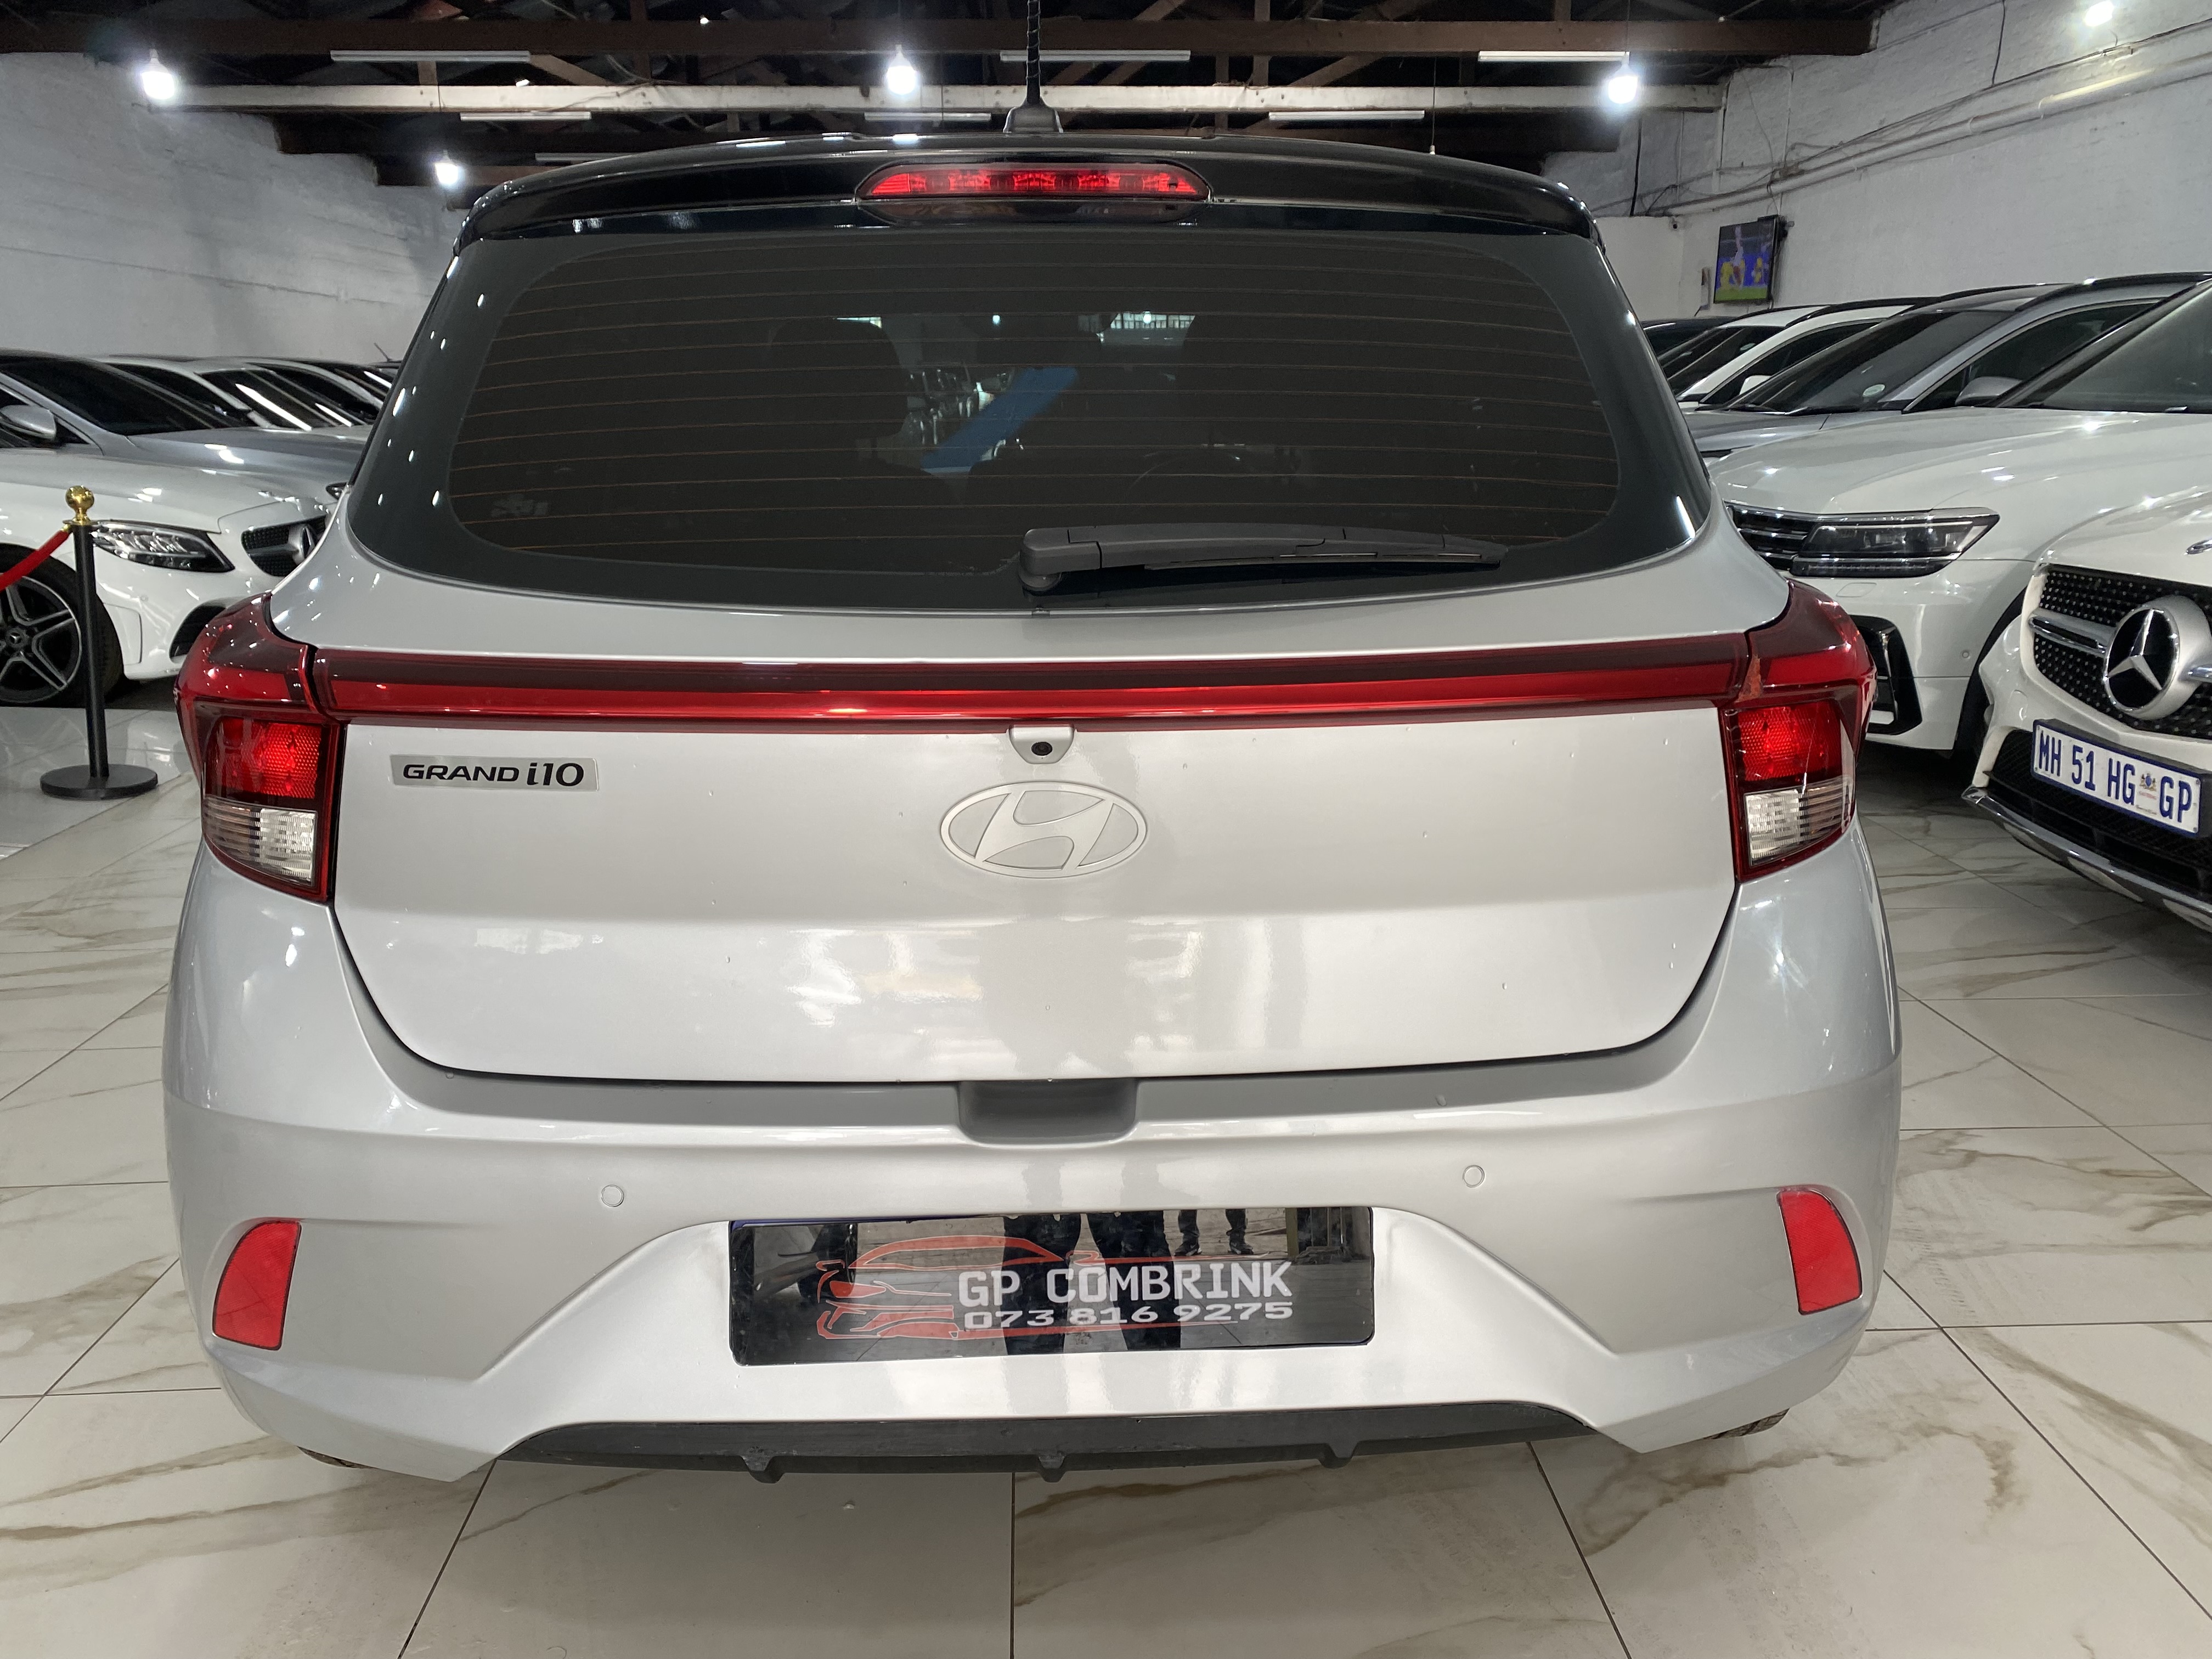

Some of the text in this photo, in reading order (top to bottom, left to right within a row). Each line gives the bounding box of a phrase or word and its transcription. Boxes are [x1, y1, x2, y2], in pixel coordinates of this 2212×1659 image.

[403, 762, 584, 786] GRAND i10
[2039, 730, 2192, 823] MH 51 HG GP
[958, 1261, 1293, 1307] GP COMBRINK
[964, 1302, 1293, 1329] 073 816 9275
